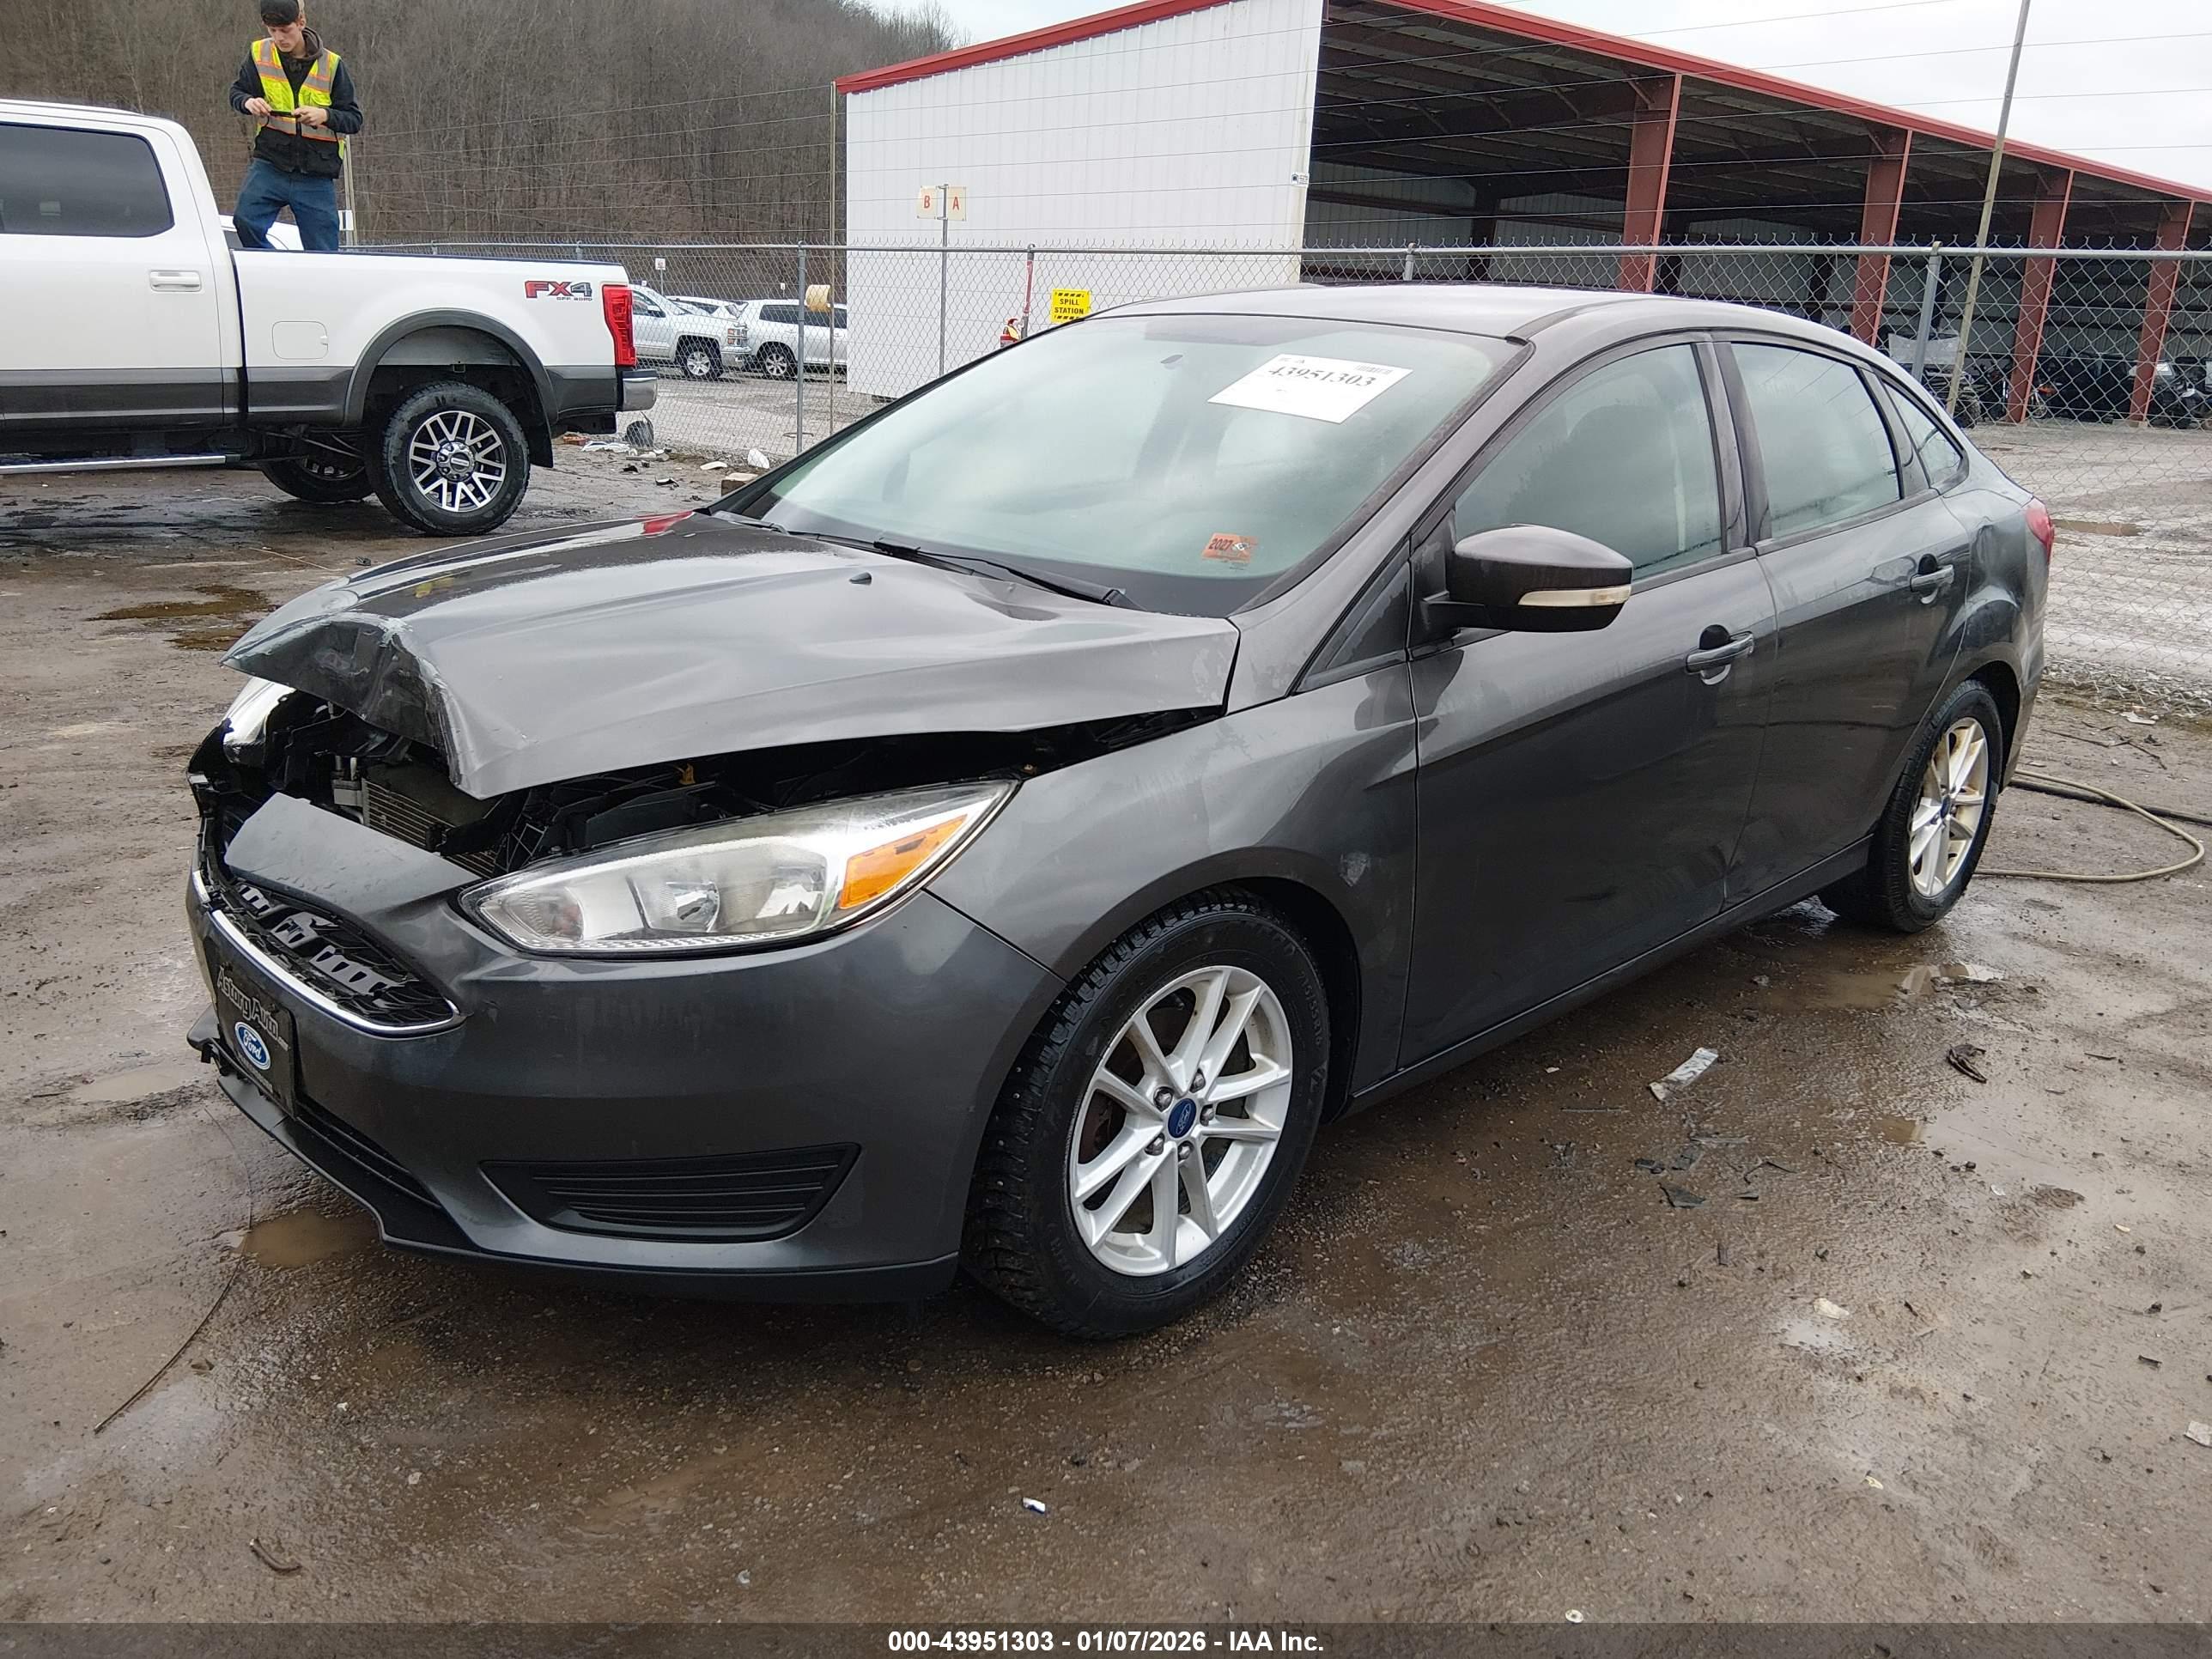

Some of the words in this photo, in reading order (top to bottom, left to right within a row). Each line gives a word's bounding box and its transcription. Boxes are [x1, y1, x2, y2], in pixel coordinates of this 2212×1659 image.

[923, 195, 931, 209] B
[952, 196, 960, 210] A
[525, 280, 592, 299] FX4
[1054, 307, 1085, 315] STATION
[1268, 366, 1376, 386] 43951303
[242, 1029, 263, 1061] Ford
